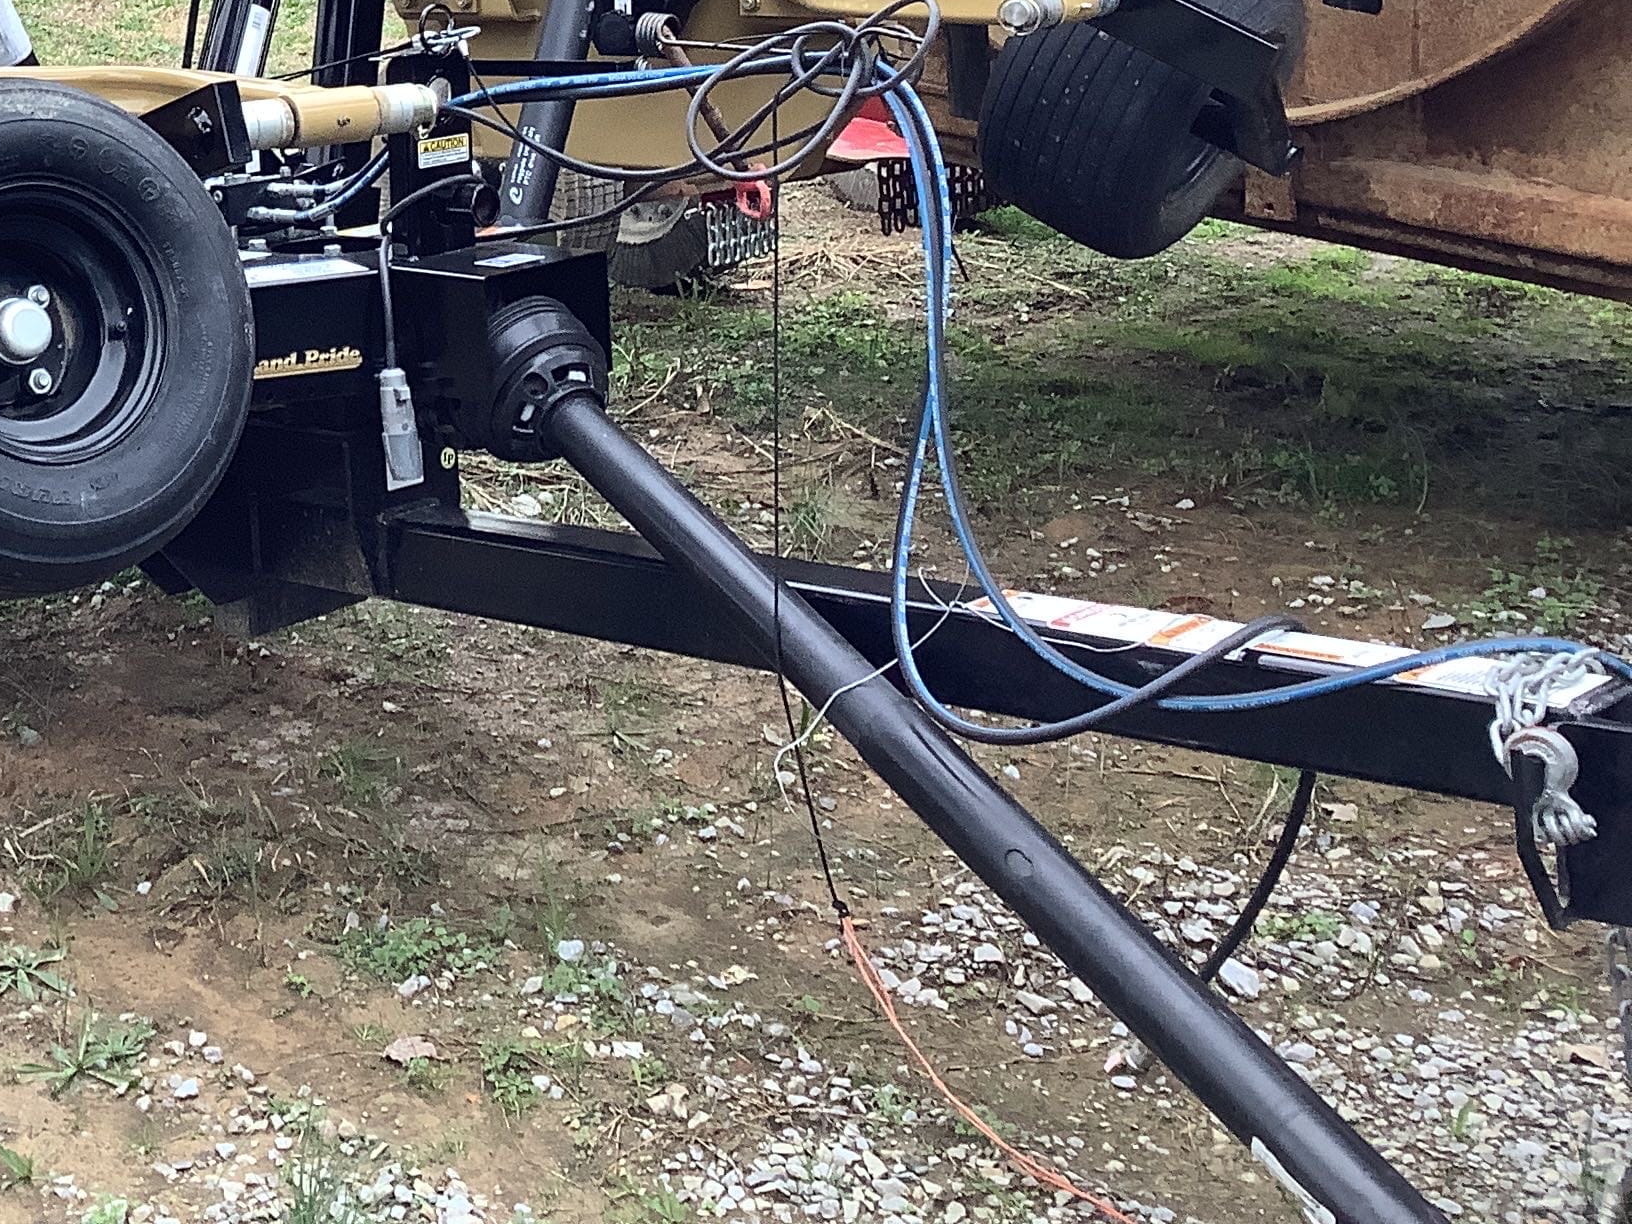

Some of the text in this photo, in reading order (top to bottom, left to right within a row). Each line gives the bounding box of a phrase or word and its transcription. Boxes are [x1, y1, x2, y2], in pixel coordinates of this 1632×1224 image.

[429, 136, 465, 153] CAUTION
[254, 345, 362, 376] and Pride
